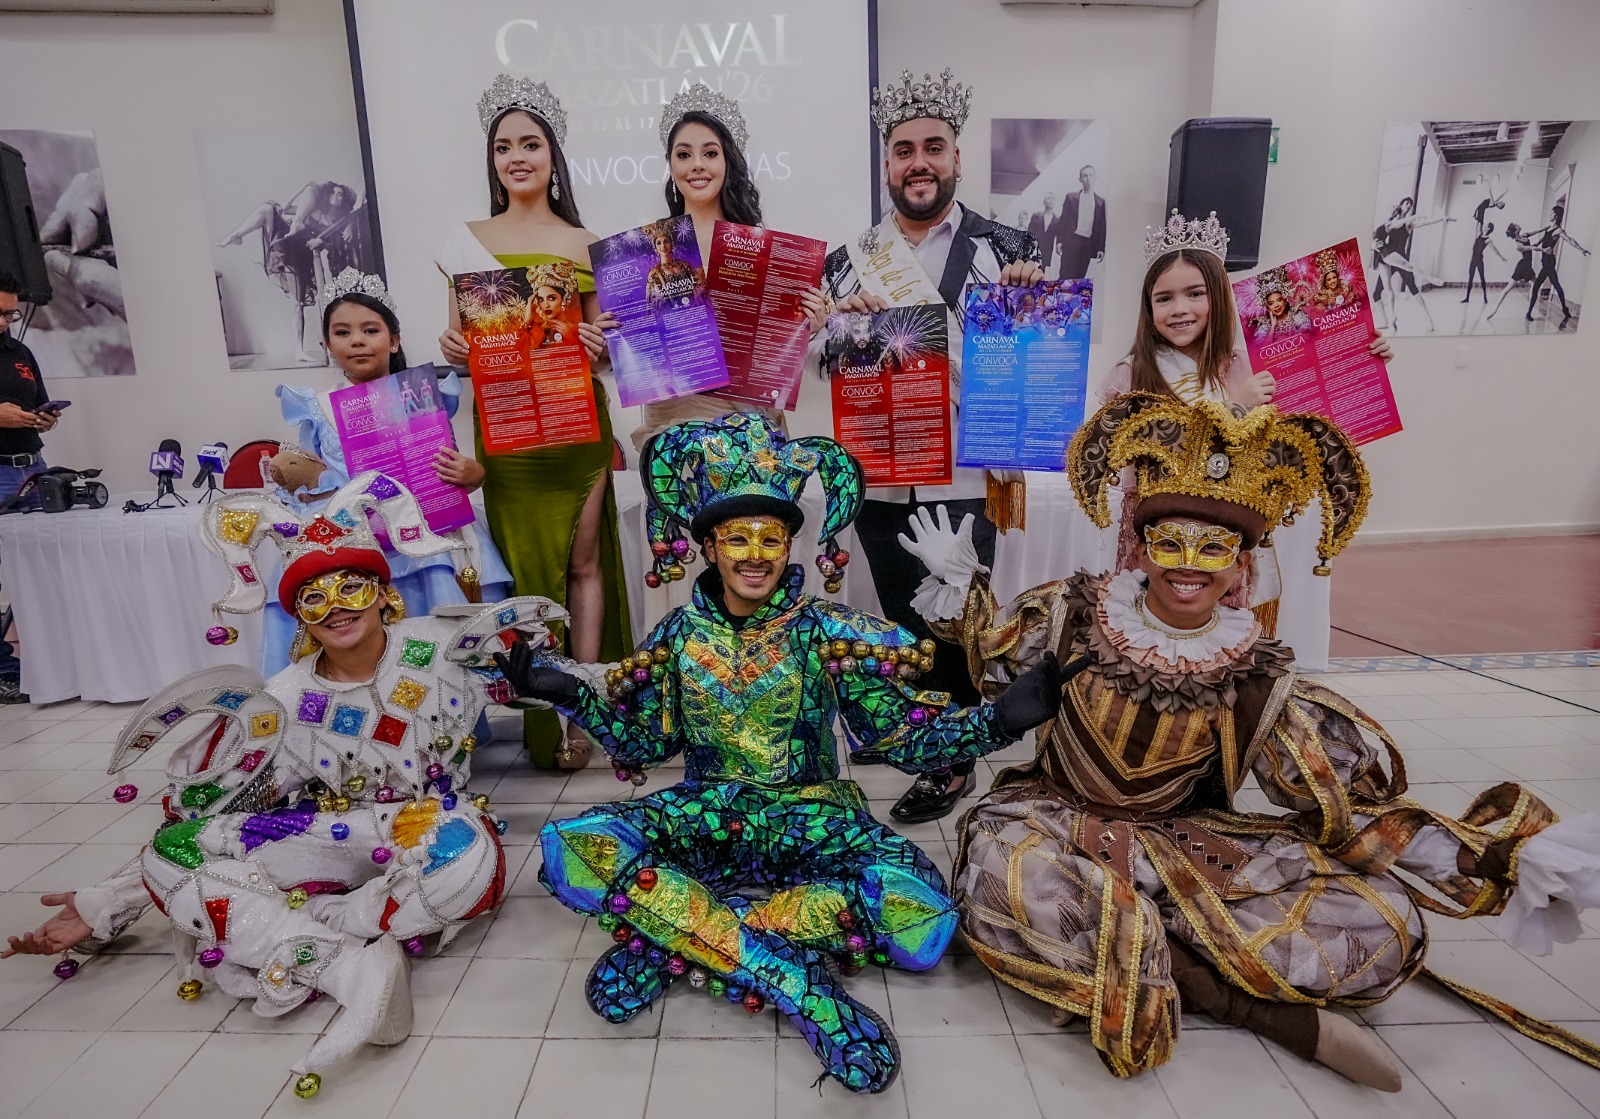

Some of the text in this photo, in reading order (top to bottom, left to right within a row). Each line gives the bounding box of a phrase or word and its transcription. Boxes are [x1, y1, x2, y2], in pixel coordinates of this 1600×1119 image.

[494, 12, 804, 73] CARNAVAL
[615, 117, 632, 130] AL
[639, 117, 654, 130] 17
[723, 233, 766, 249] CARNAVAL
[724, 258, 755, 270] CONVOCA
[602, 266, 641, 284] CONVOCA
[880, 267, 912, 287] de
[654, 275, 697, 293] CARNAVAL
[1312, 303, 1361, 327] CARNAVAL
[474, 331, 520, 345] CARNAVAL
[972, 335, 1020, 344] CARNAVAL
[1259, 335, 1306, 360] CONVOCA
[478, 353, 523, 367] CONVOCA
[972, 355, 1018, 366] CONVOCA
[839, 363, 884, 375] CARNAVAL
[841, 385, 885, 397] CONVOCA
[345, 412, 386, 430] CONVOCA
